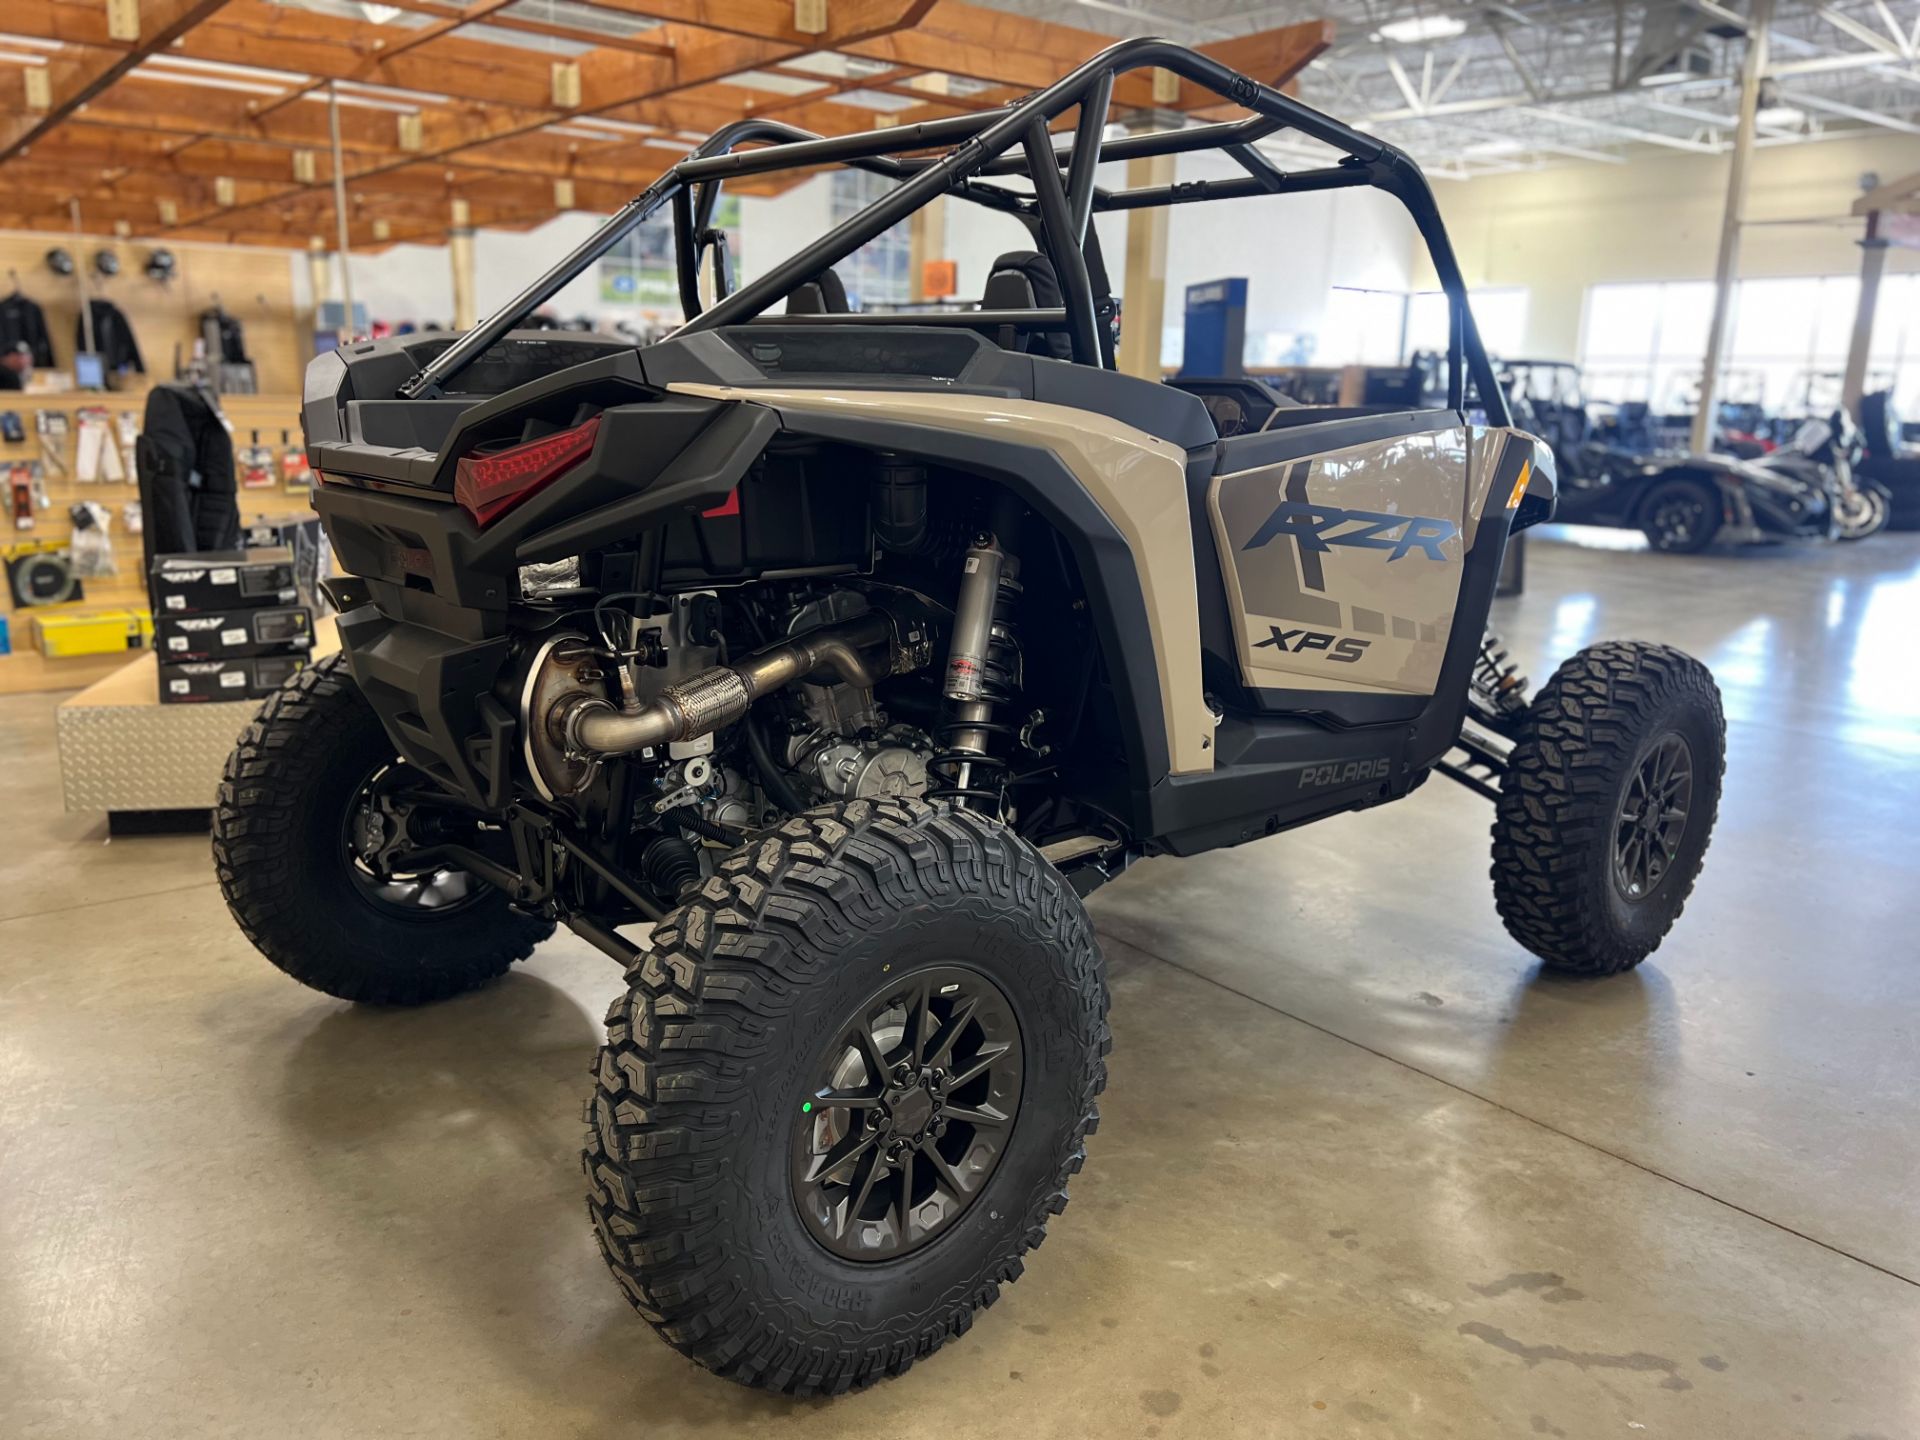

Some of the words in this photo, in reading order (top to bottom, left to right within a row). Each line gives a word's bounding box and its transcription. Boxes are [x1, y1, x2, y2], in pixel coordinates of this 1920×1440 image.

[1241, 501, 1458, 562] RZR
[1253, 625, 1372, 663] XPS
[1297, 757, 1391, 789] POLARIS
